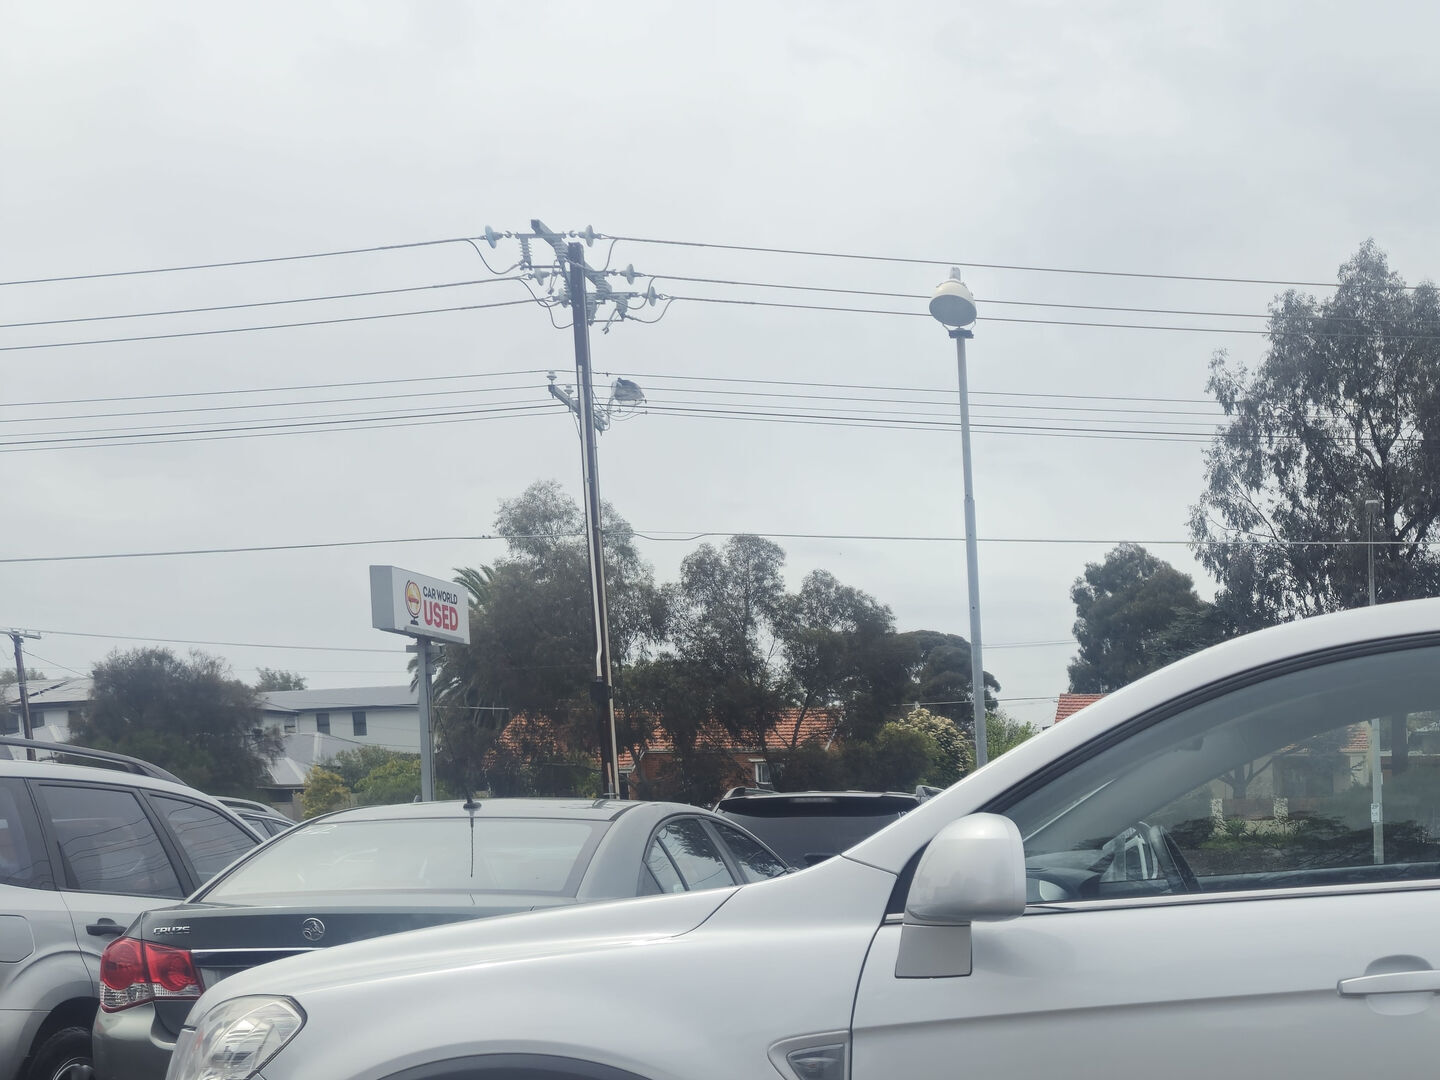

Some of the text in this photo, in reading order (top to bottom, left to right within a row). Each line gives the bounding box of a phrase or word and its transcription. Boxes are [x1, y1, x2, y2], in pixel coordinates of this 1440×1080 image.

[423, 587, 457, 604] CAR WORLD
[424, 600, 458, 631] USED
[153, 926, 191, 935] CRUZE
